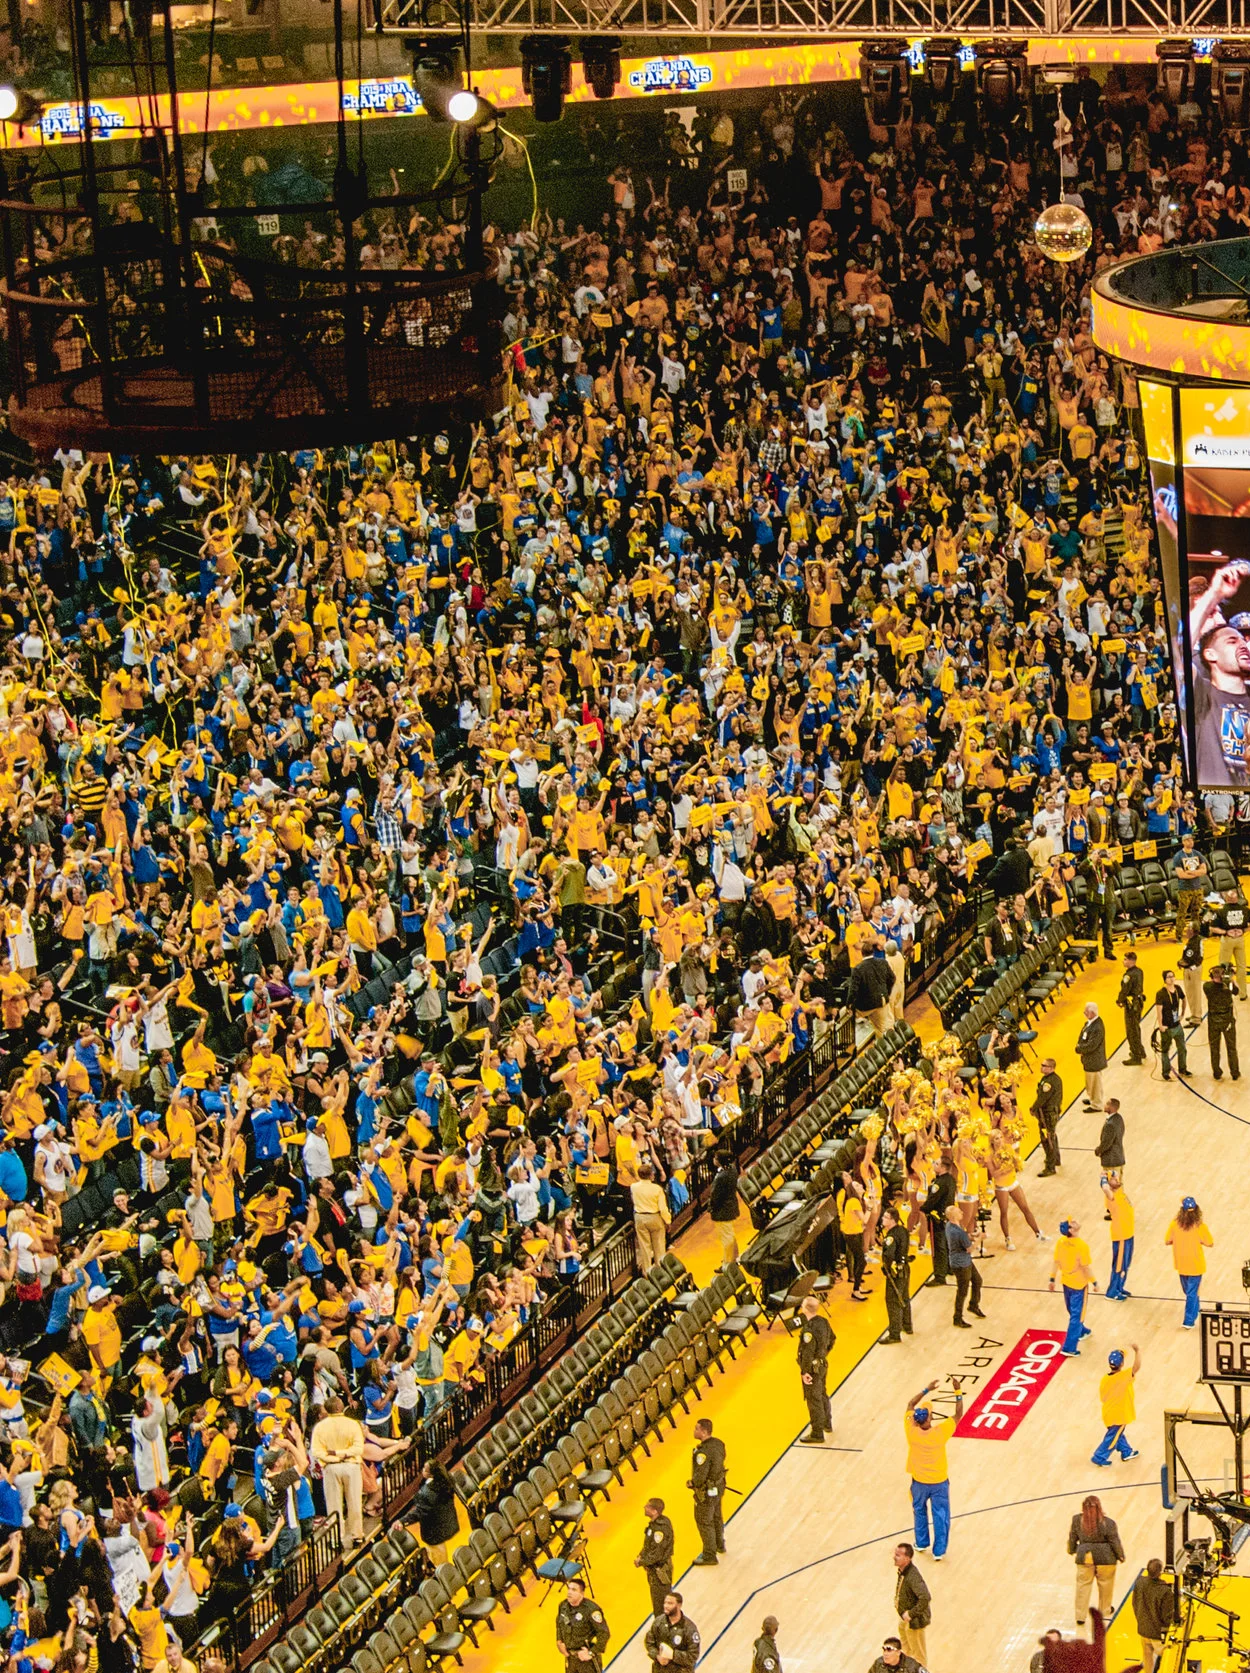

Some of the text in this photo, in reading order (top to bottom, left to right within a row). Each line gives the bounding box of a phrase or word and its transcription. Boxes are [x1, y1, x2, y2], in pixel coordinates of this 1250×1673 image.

[670, 60, 691, 71] NBA
[630, 67, 711, 86] CHAMPIONS
[384, 82, 407, 92] NBA
[731, 179, 745, 189] 119
[260, 221, 278, 232] 119
[971, 1339, 1062, 1430] ORACLE
